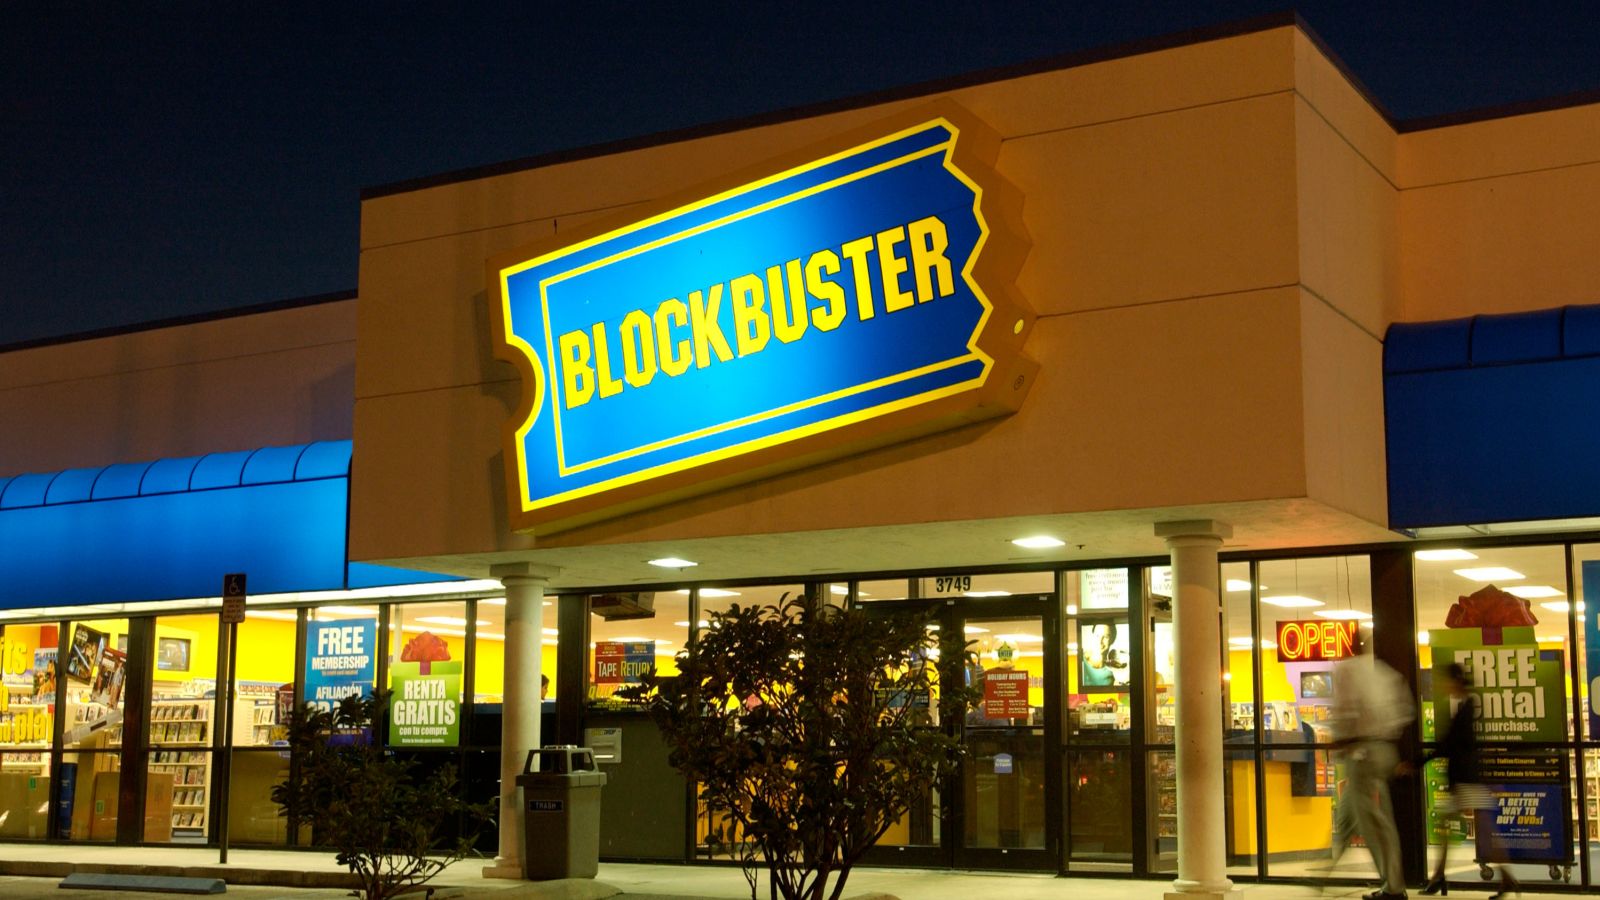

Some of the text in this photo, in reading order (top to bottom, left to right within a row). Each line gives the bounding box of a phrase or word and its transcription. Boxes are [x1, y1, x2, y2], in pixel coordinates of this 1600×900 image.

[558, 215, 955, 410] BLOCKBUSTER
[936, 576, 971, 593] 3749
[318, 626, 364, 655] FREE
[1281, 622, 1355, 659] OPEN
[311, 655, 370, 671] MEMBERSHIP
[315, 682, 362, 700] AFILIACIÓN
[404, 680, 446, 699] RENTA
[393, 700, 456, 726] GRATIS
[1485, 720, 1539, 733] purchase.
[1498, 797, 1539, 807] A BETTER
[1502, 806, 1536, 816] WAY TO
[1496, 815, 1516, 825] BUY
